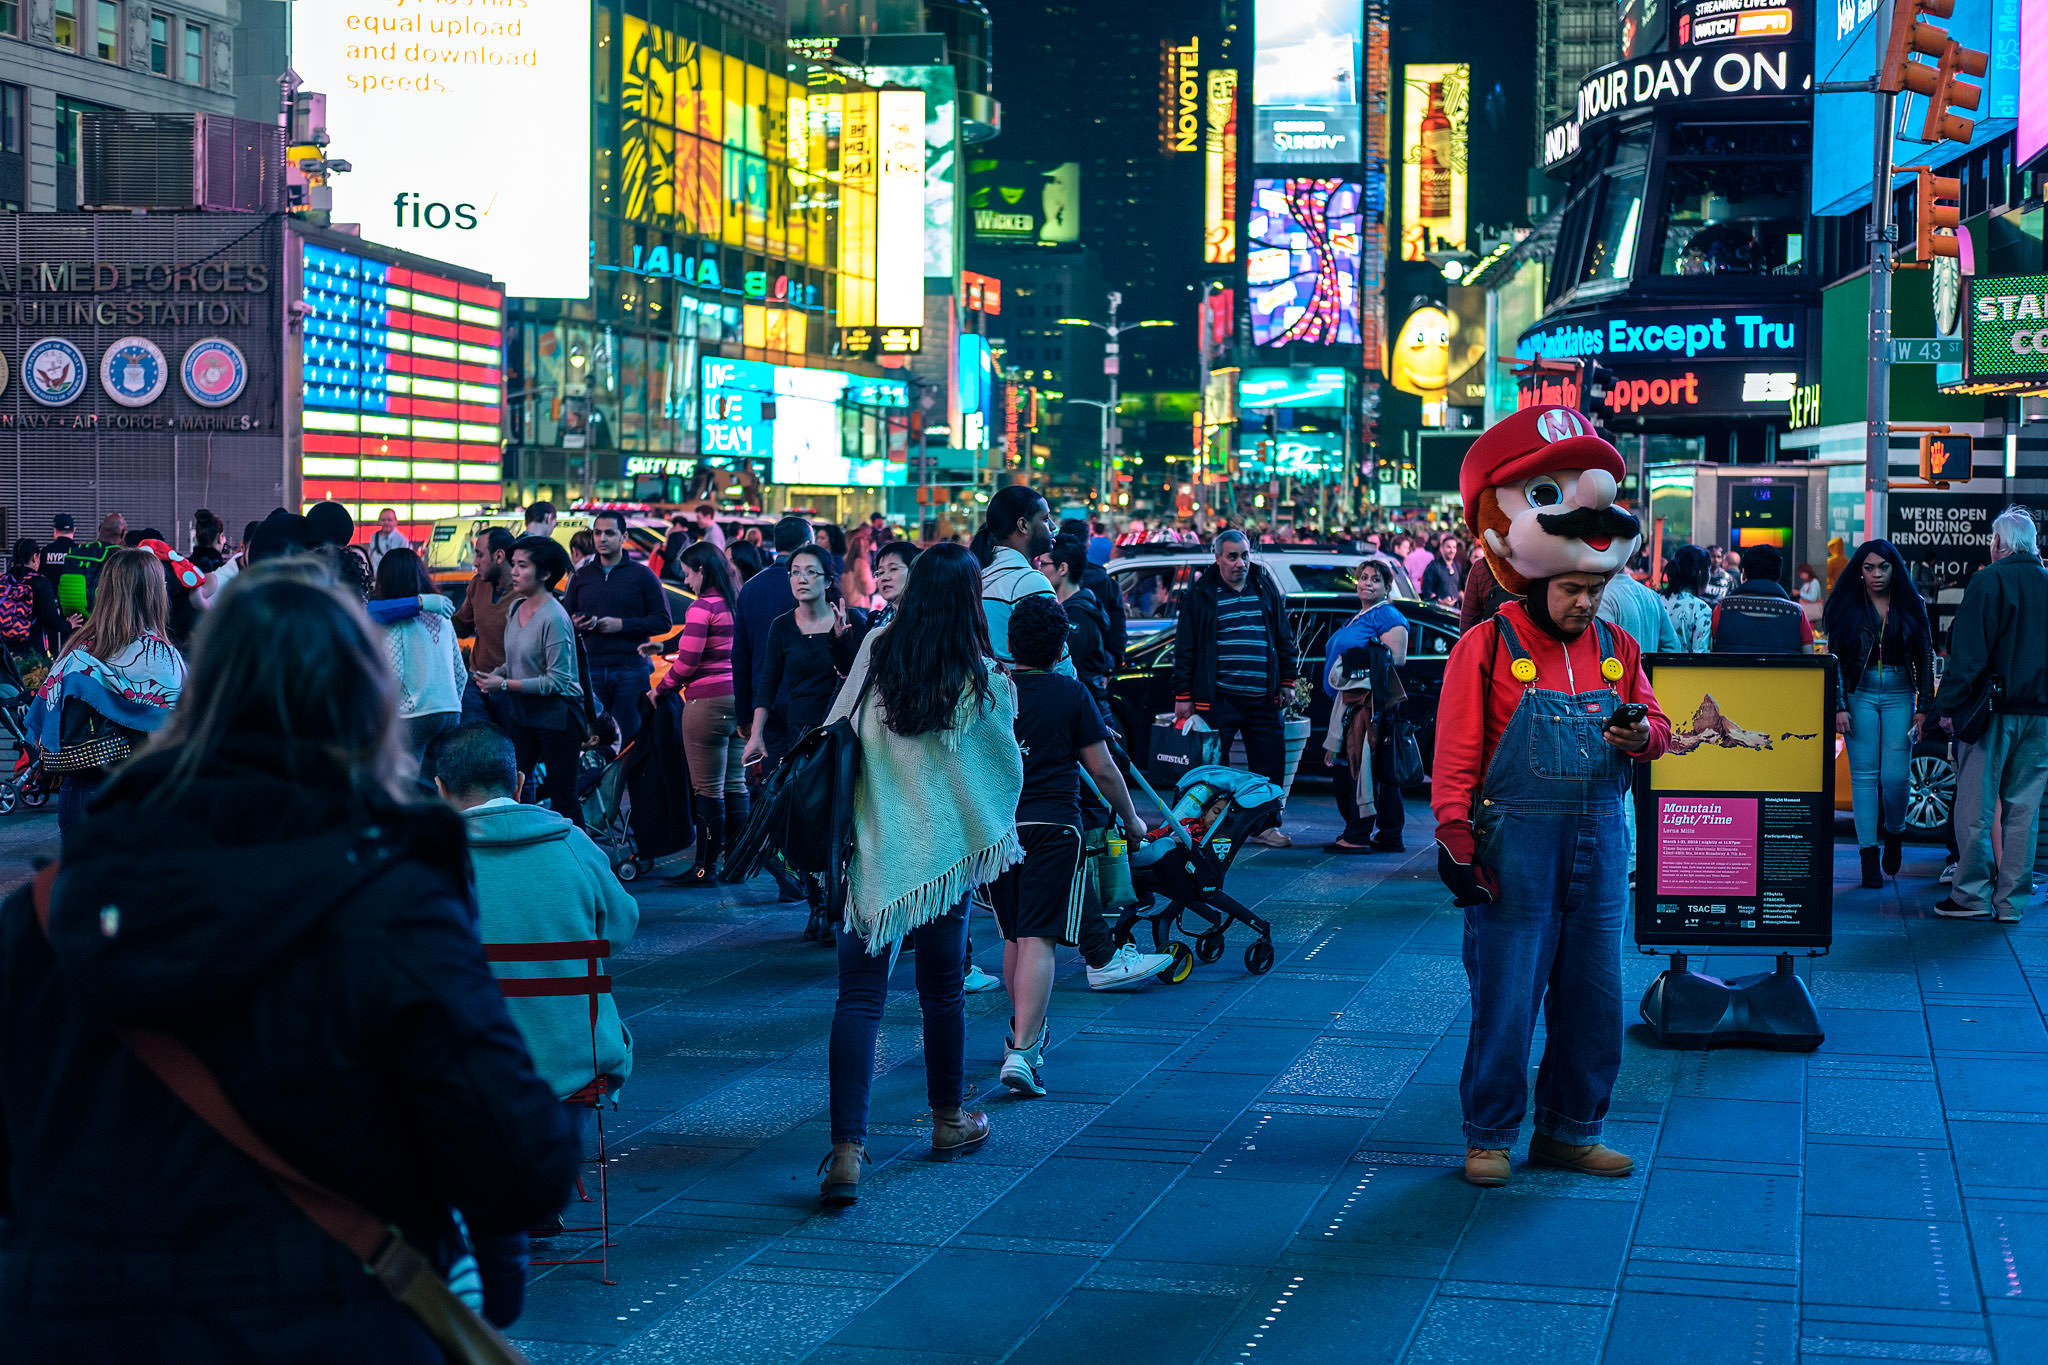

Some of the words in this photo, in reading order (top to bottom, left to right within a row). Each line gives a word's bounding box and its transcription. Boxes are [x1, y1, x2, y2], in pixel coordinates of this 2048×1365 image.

[346, 14, 421, 34] equal
[430, 16, 521, 38] upload
[1695, 18, 1736, 39] WATCH
[347, 43, 396, 60] and
[405, 43, 537, 66] download
[1176, 35, 1199, 151] NOVOTEL
[1583, 69, 1628, 120] YOUR
[1634, 56, 1702, 102] DAY
[1713, 52, 1787, 92] ON
[394, 192, 477, 229] fios
[125, 262, 268, 292] FORCES
[0, 301, 117, 325] RUITING
[126, 301, 249, 325] STATION
[1977, 293, 2048, 322] STA
[1609, 317, 1726, 357] Except
[1735, 315, 1795, 348] Tru
[1898, 343, 1912, 360] W
[1918, 342, 1941, 360] 43
[1949, 342, 1961, 351] ST
[1605, 372, 1698, 413] pport
[1789, 384, 1820, 430] SEPH
[3, 414, 50, 428] NAVY
[73, 414, 98, 428] AIR
[106, 414, 162, 429] FORCE
[179, 414, 250, 430] MARINES
[1544, 411, 1578, 443] M
[1900, 506, 1943, 520] WE'RE
[1947, 508, 1987, 521] OPEN
[1915, 520, 1972, 533] DURING
[1891, 532, 1993, 546] RENOVATIONS
[1663, 803, 1721, 813] Mountain
[1663, 814, 1732, 825] Light/Time
[1688, 905, 1710, 913] TSAC
